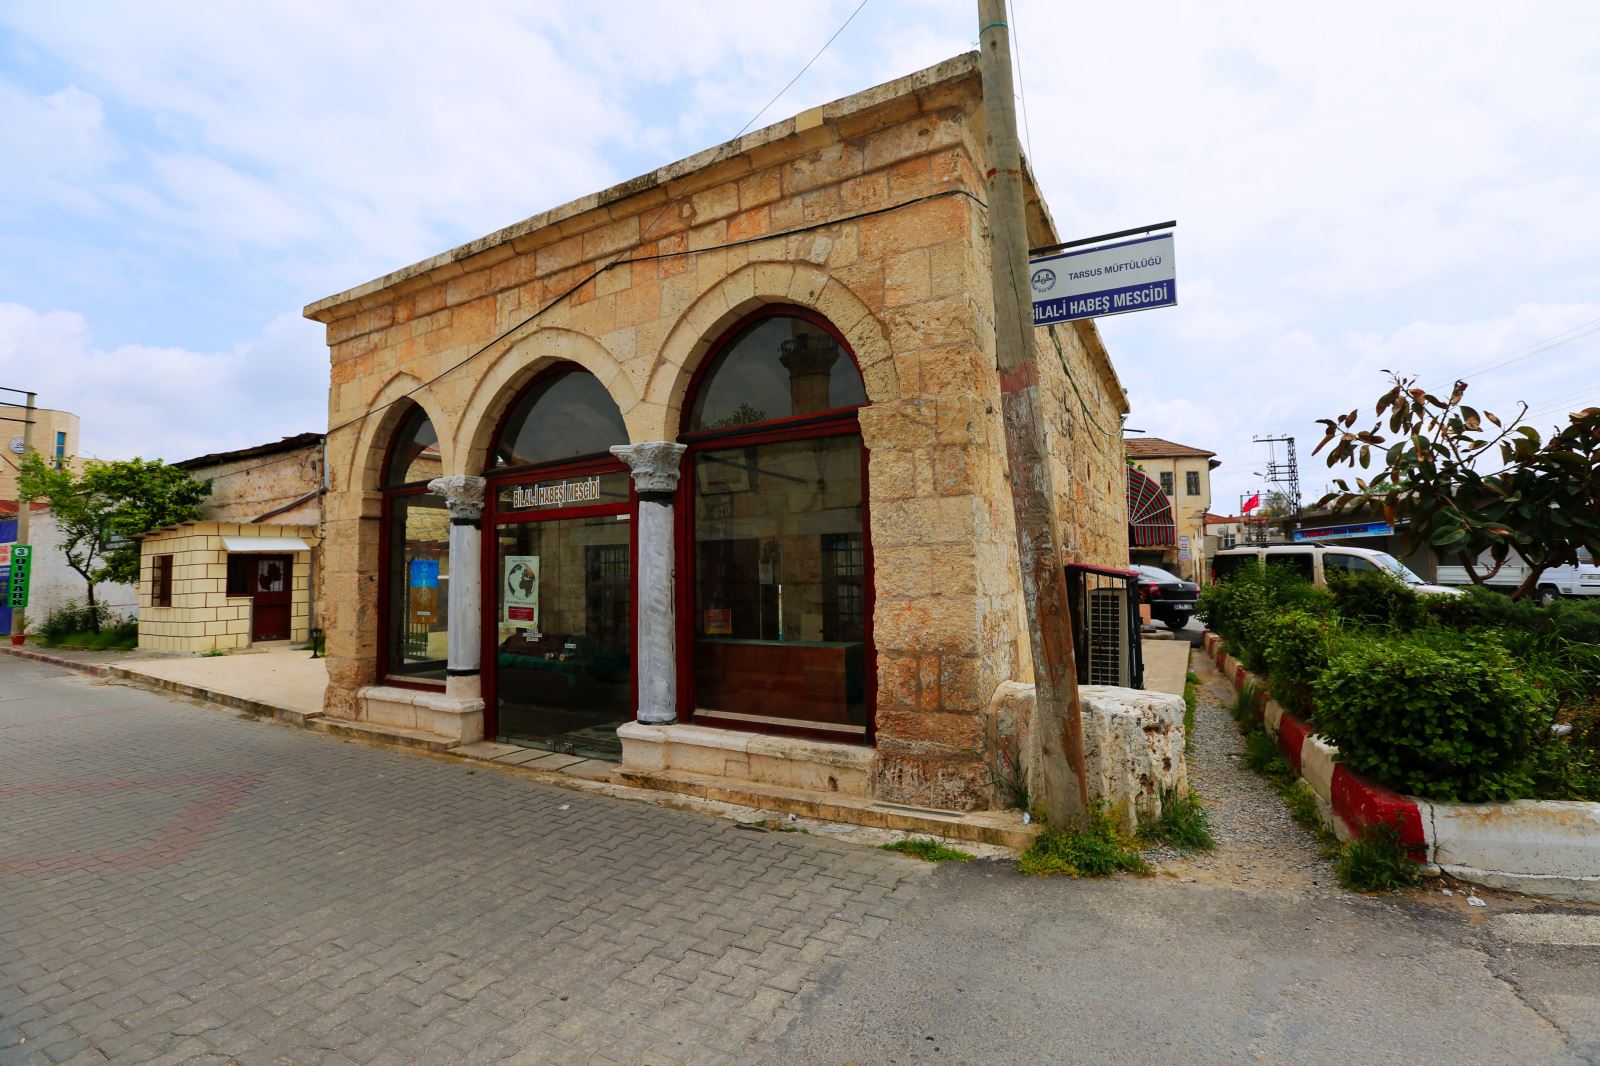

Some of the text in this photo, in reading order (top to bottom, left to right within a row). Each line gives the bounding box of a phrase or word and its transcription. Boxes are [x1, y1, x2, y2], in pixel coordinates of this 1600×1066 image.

[1068, 256, 1162, 280] TARSUS MÜFTÜLÜĞÜ
[1070, 296, 1110, 314] HABEŞ
[1114, 283, 1168, 307] MESCİDİ
[513, 475, 600, 508] BİLAL-İ HABEŞİ MESCİDİ
[12, 548, 26, 606] 3 OTOPARK
